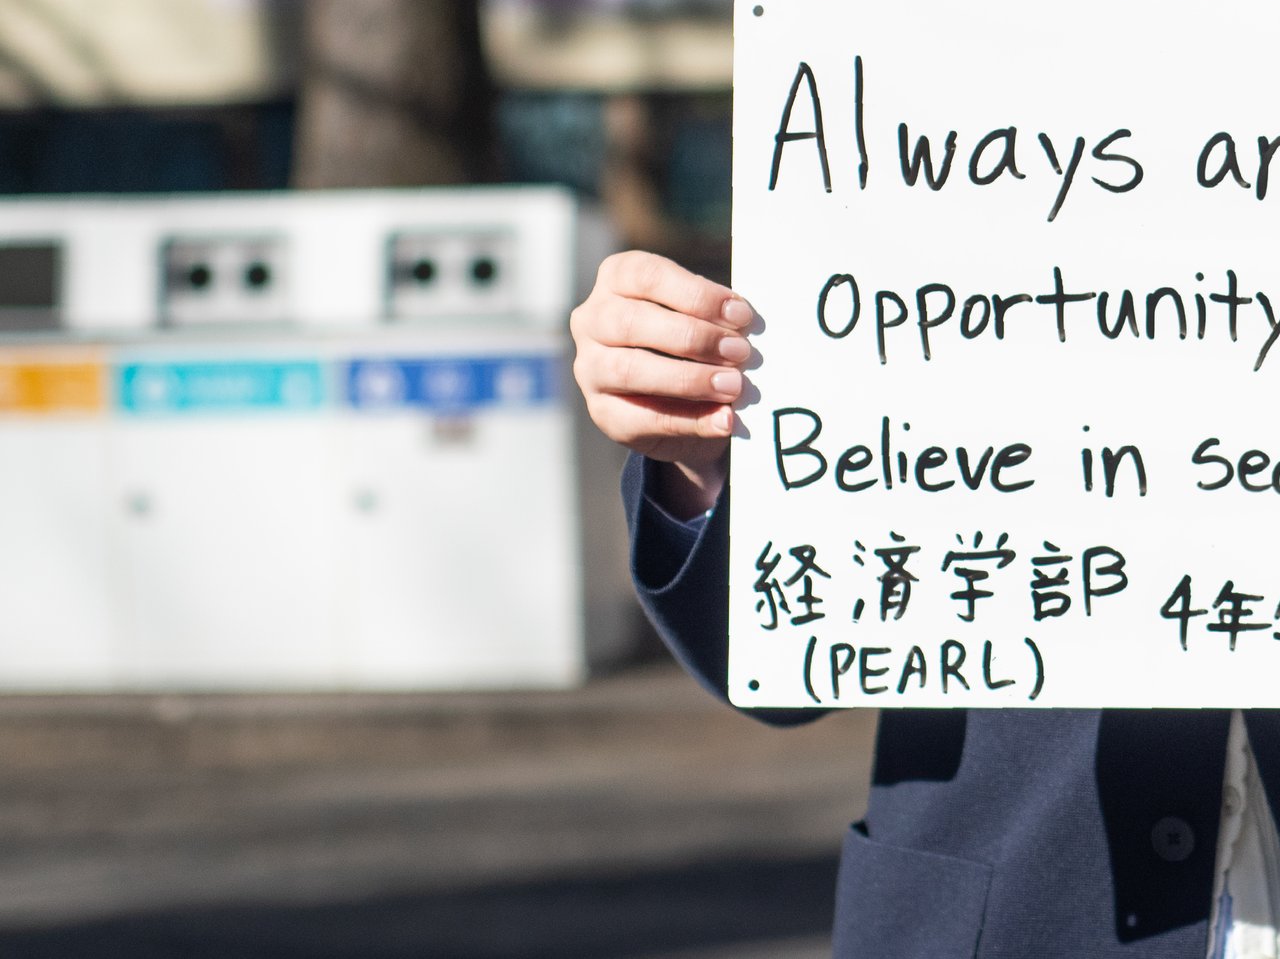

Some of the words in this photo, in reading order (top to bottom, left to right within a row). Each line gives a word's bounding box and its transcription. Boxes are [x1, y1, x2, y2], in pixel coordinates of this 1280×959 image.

[767, 54, 1145, 224] Always
[771, 406, 1036, 494] Believe
[1080, 424, 1148, 499] in
[752, 529, 1130, 632] 経済学部
[802, 634, 1046, 705] (PEARL)
